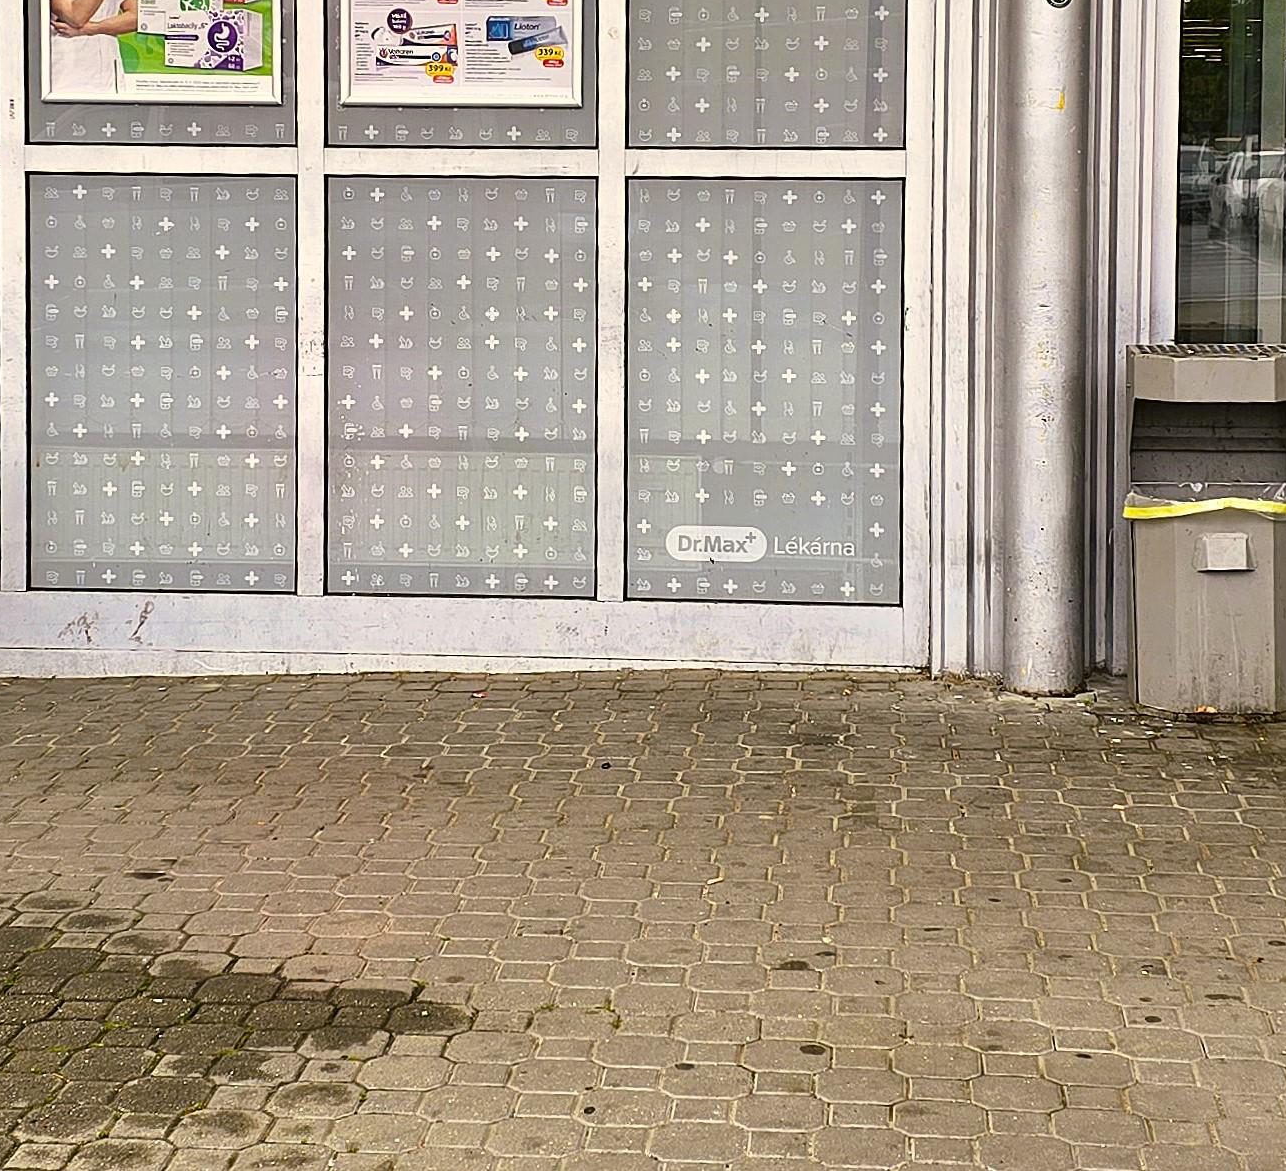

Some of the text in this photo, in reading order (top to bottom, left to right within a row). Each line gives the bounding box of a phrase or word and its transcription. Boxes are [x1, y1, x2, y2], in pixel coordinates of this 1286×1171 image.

[514, 23, 539, 31] Lioton
[538, 48, 554, 56] 339
[427, 64, 444, 72] 399
[677, 534, 856, 557] Dr.Max Lékárna
